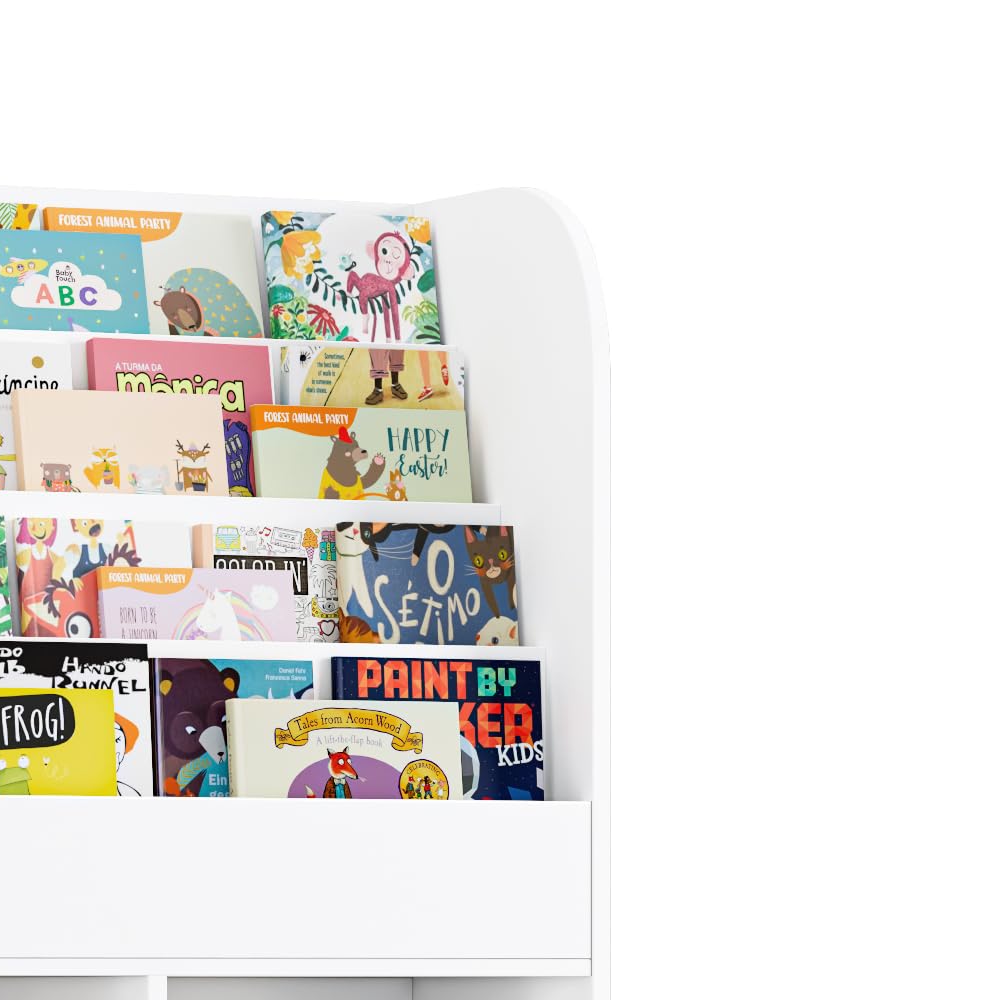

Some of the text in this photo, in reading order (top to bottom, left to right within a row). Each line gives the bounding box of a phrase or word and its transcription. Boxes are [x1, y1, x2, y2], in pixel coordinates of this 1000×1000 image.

[58, 214, 171, 230] FOREST ANIMAL PARTY
[55, 269, 73, 278] Baby
[115, 362, 163, 371] A TURMA DA
[264, 411, 349, 425] FOREST ANIMAL PARTY
[387, 427, 450, 452] HAPPY
[395, 454, 448, 480] Easter!
[109, 572, 186, 584] FOREST ANIMAL PARTY
[427, 540, 455, 596] O
[120, 606, 158, 624] BORN TO BE
[357, 660, 517, 699] PAINT BY
[1, 697, 65, 746] FROG!
[294, 712, 403, 735] Tales from Acorn Wood
[495, 739, 543, 767] KIDS
[406, 762, 441, 777] CELEBRATING
